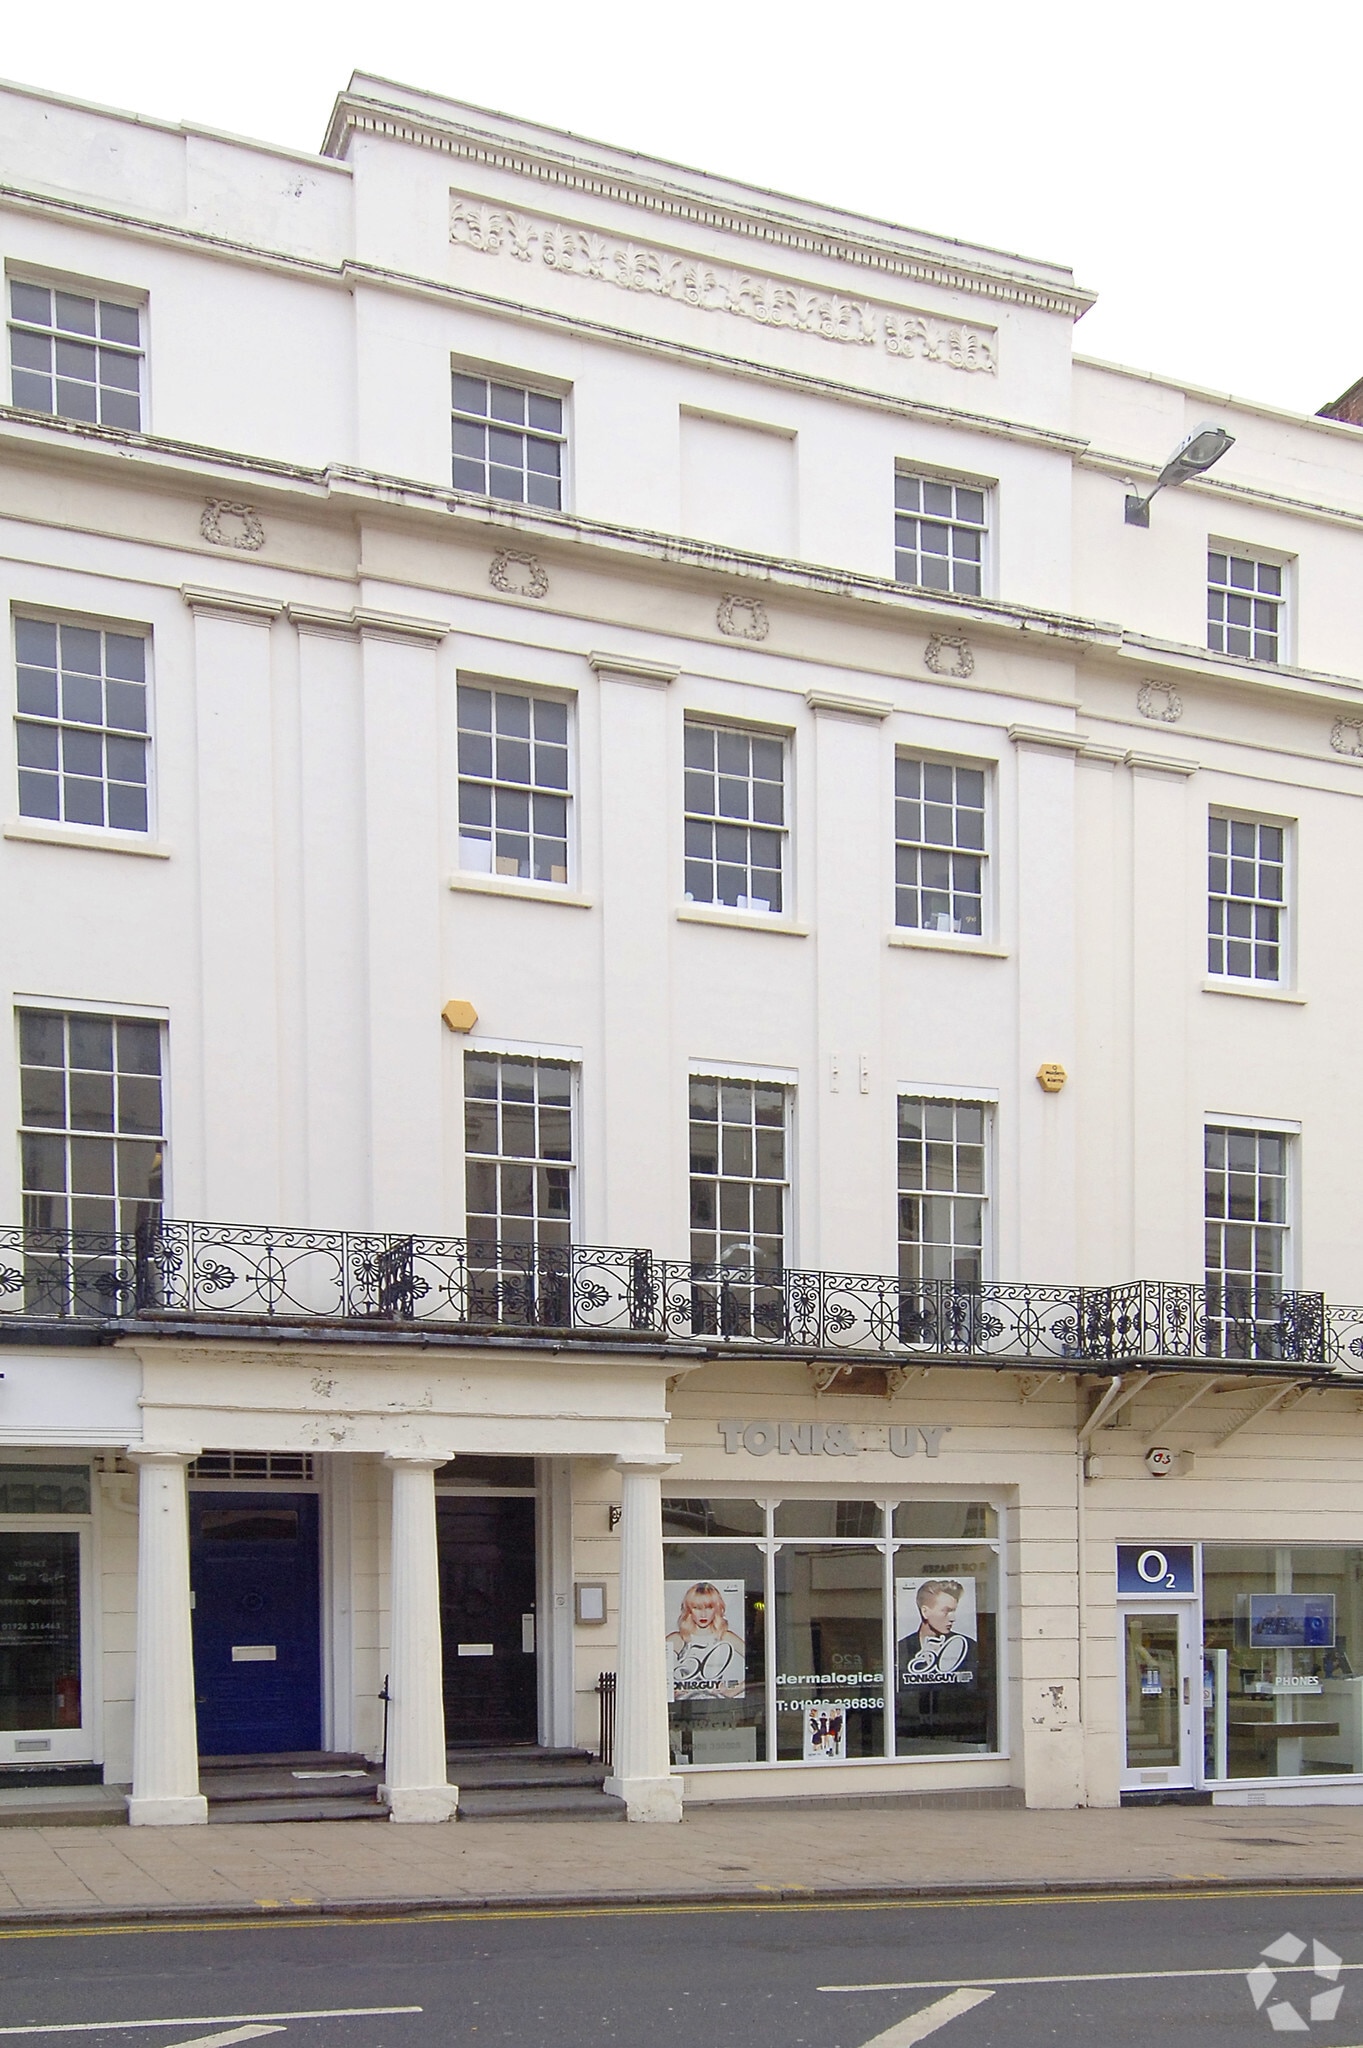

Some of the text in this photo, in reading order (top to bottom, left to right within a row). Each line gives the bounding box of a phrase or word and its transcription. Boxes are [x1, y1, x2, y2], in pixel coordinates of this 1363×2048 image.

[776, 1671, 885, 1685] dermalogica
[903, 1672, 956, 1684] TONI&GUY
[1275, 1675, 1320, 1687] PHONES
[673, 1680, 722, 1691] ONI&GUY
[776, 1700, 788, 1711] T:
